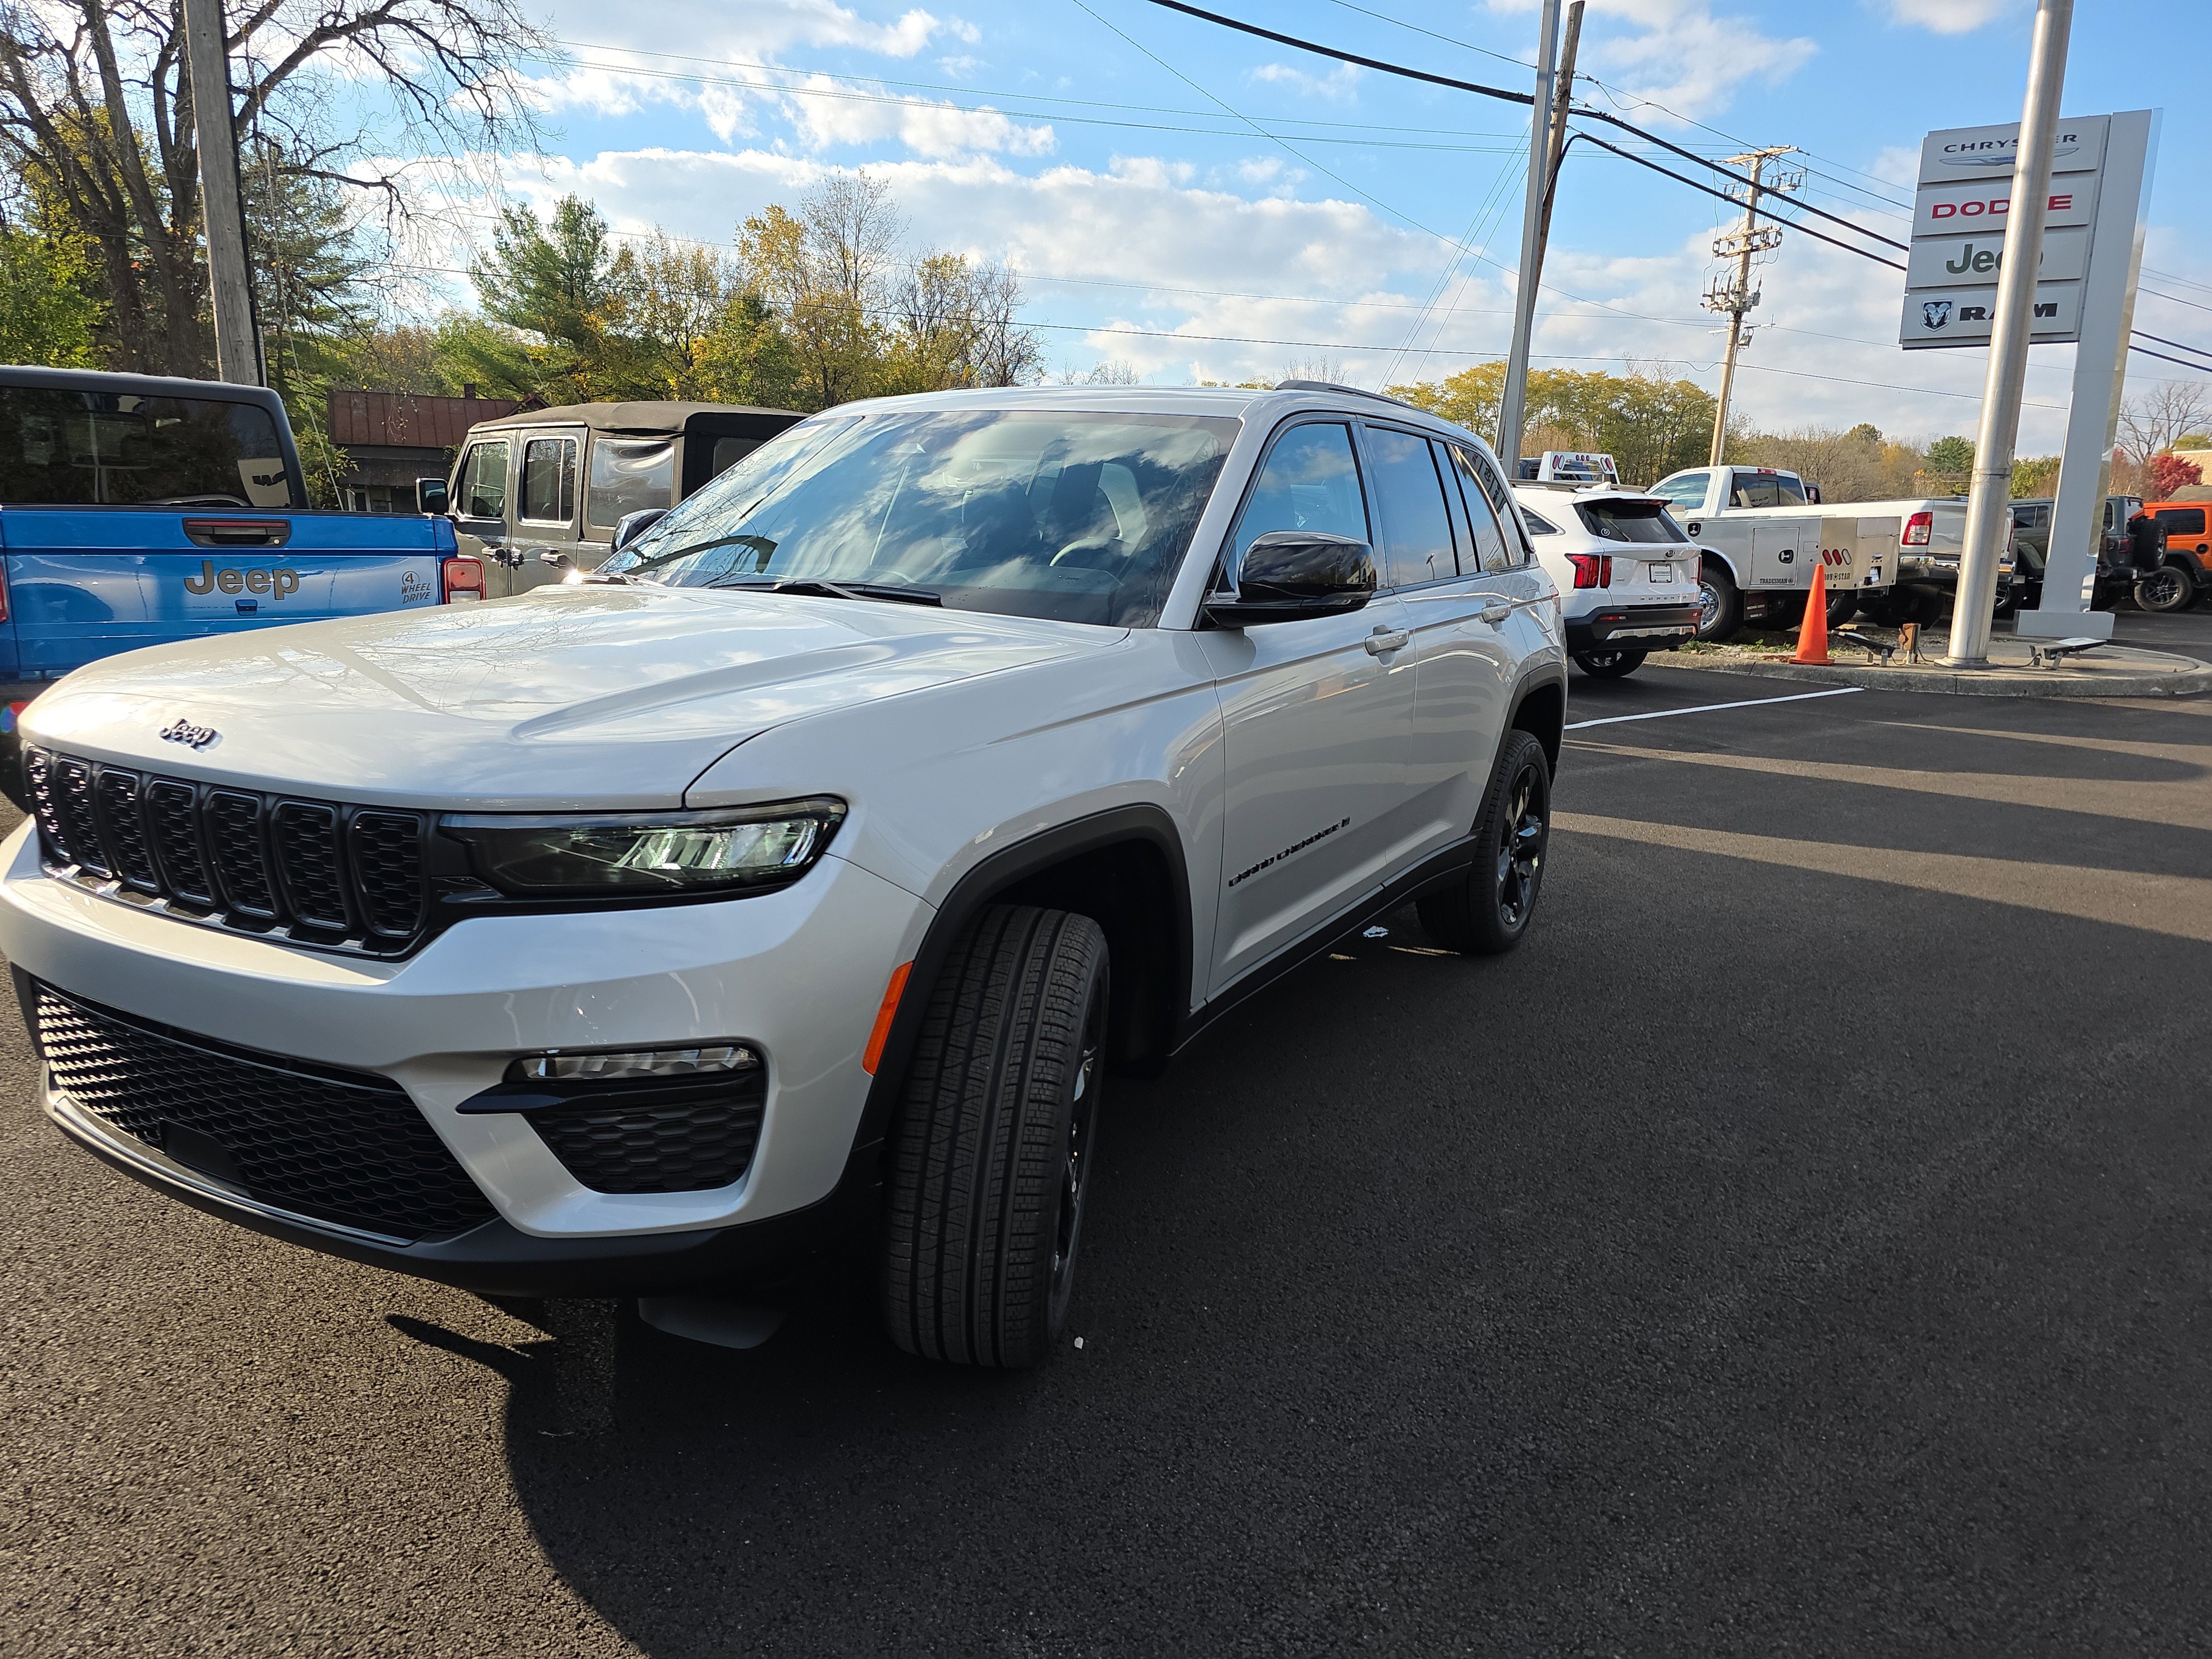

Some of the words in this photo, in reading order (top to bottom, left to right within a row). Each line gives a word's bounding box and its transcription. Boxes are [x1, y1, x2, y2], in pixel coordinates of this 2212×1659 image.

[1944, 134, 2077, 153] CHRYSR
[1932, 195, 2073, 219] DODE
[1946, 243, 2043, 274] Je
[1959, 303, 2058, 321] RM
[184, 561, 300, 600] Jeep
[401, 583, 431, 595] WHEEL
[403, 591, 431, 605] DRIVE
[159, 718, 215, 748] Jeep
